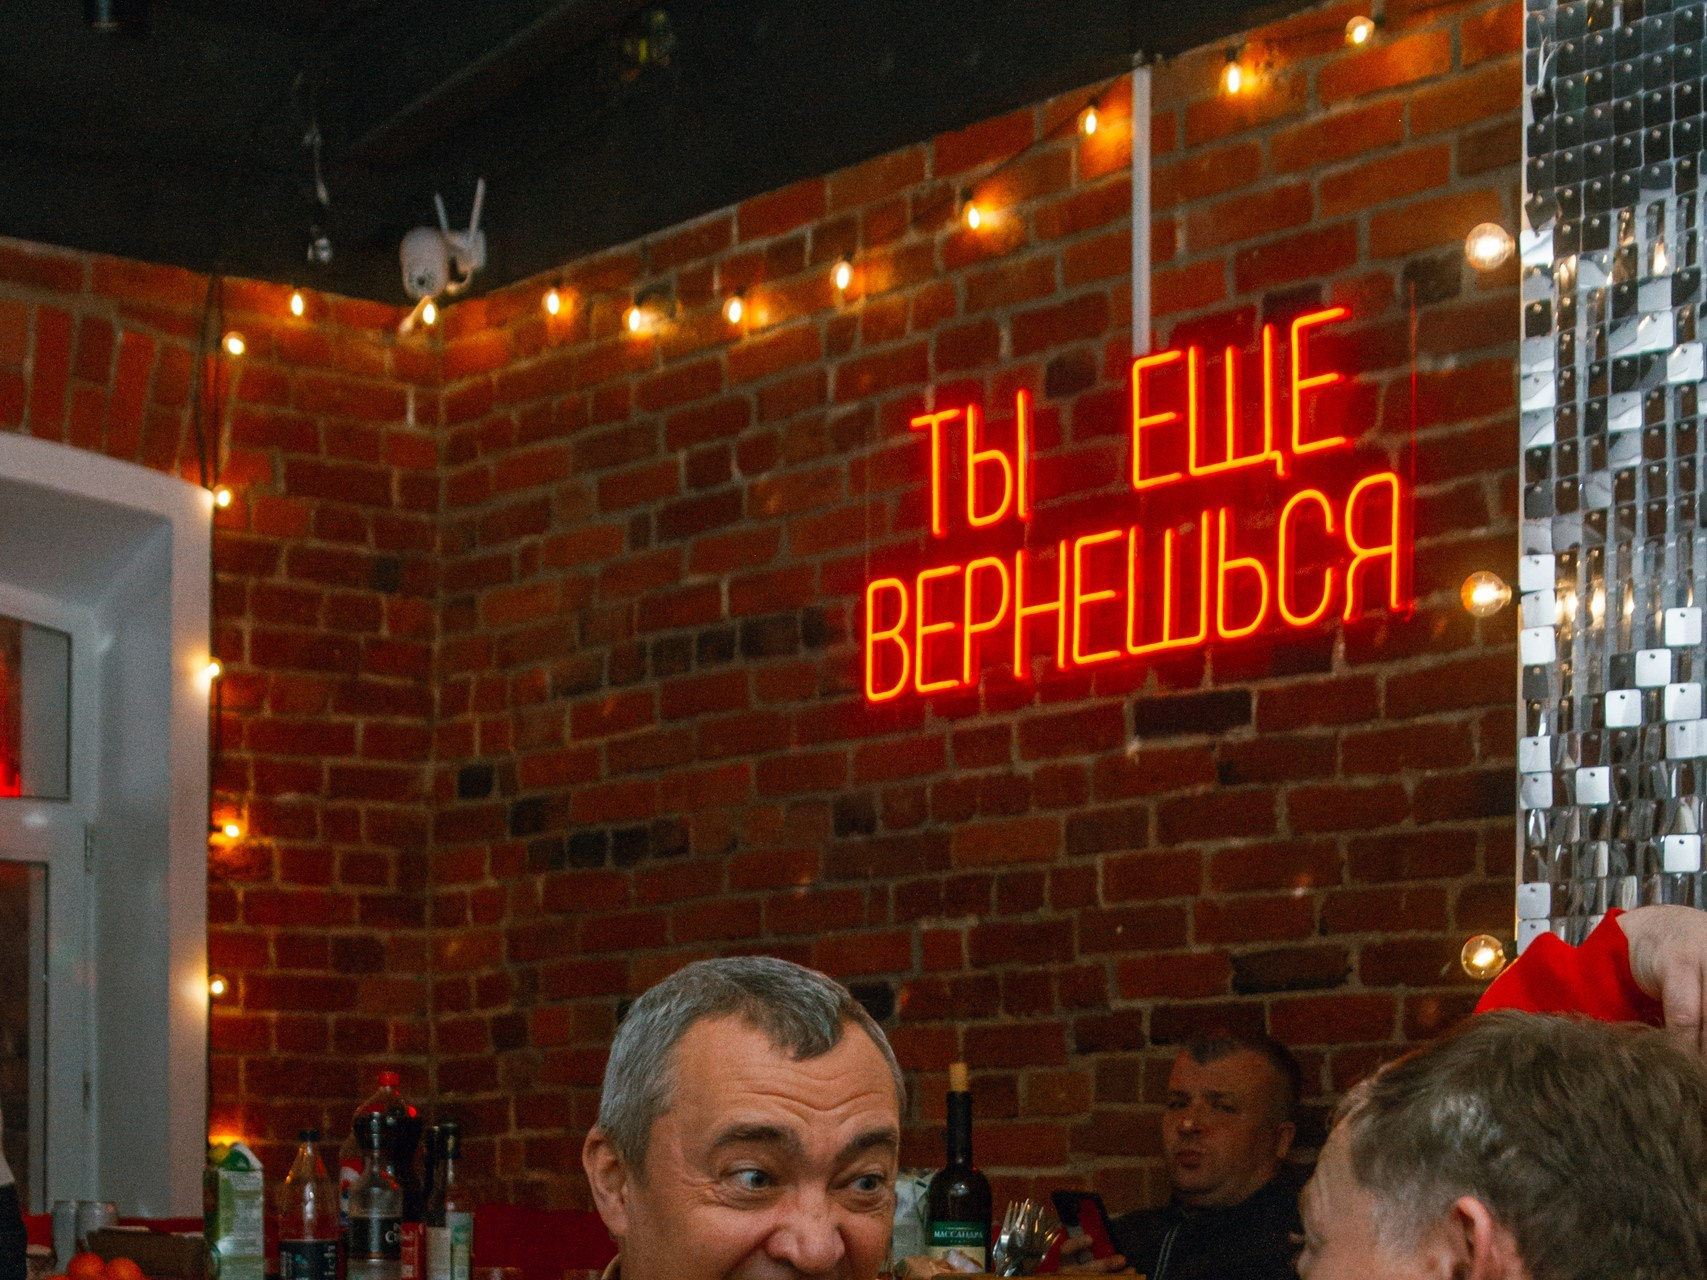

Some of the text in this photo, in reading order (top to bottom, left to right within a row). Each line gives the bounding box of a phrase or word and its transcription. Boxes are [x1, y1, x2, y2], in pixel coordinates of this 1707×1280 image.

[911, 307, 1351, 535] ТЫ ЕЩЕ
[866, 472, 1401, 702] ВЕРНЕШЬСЯ
